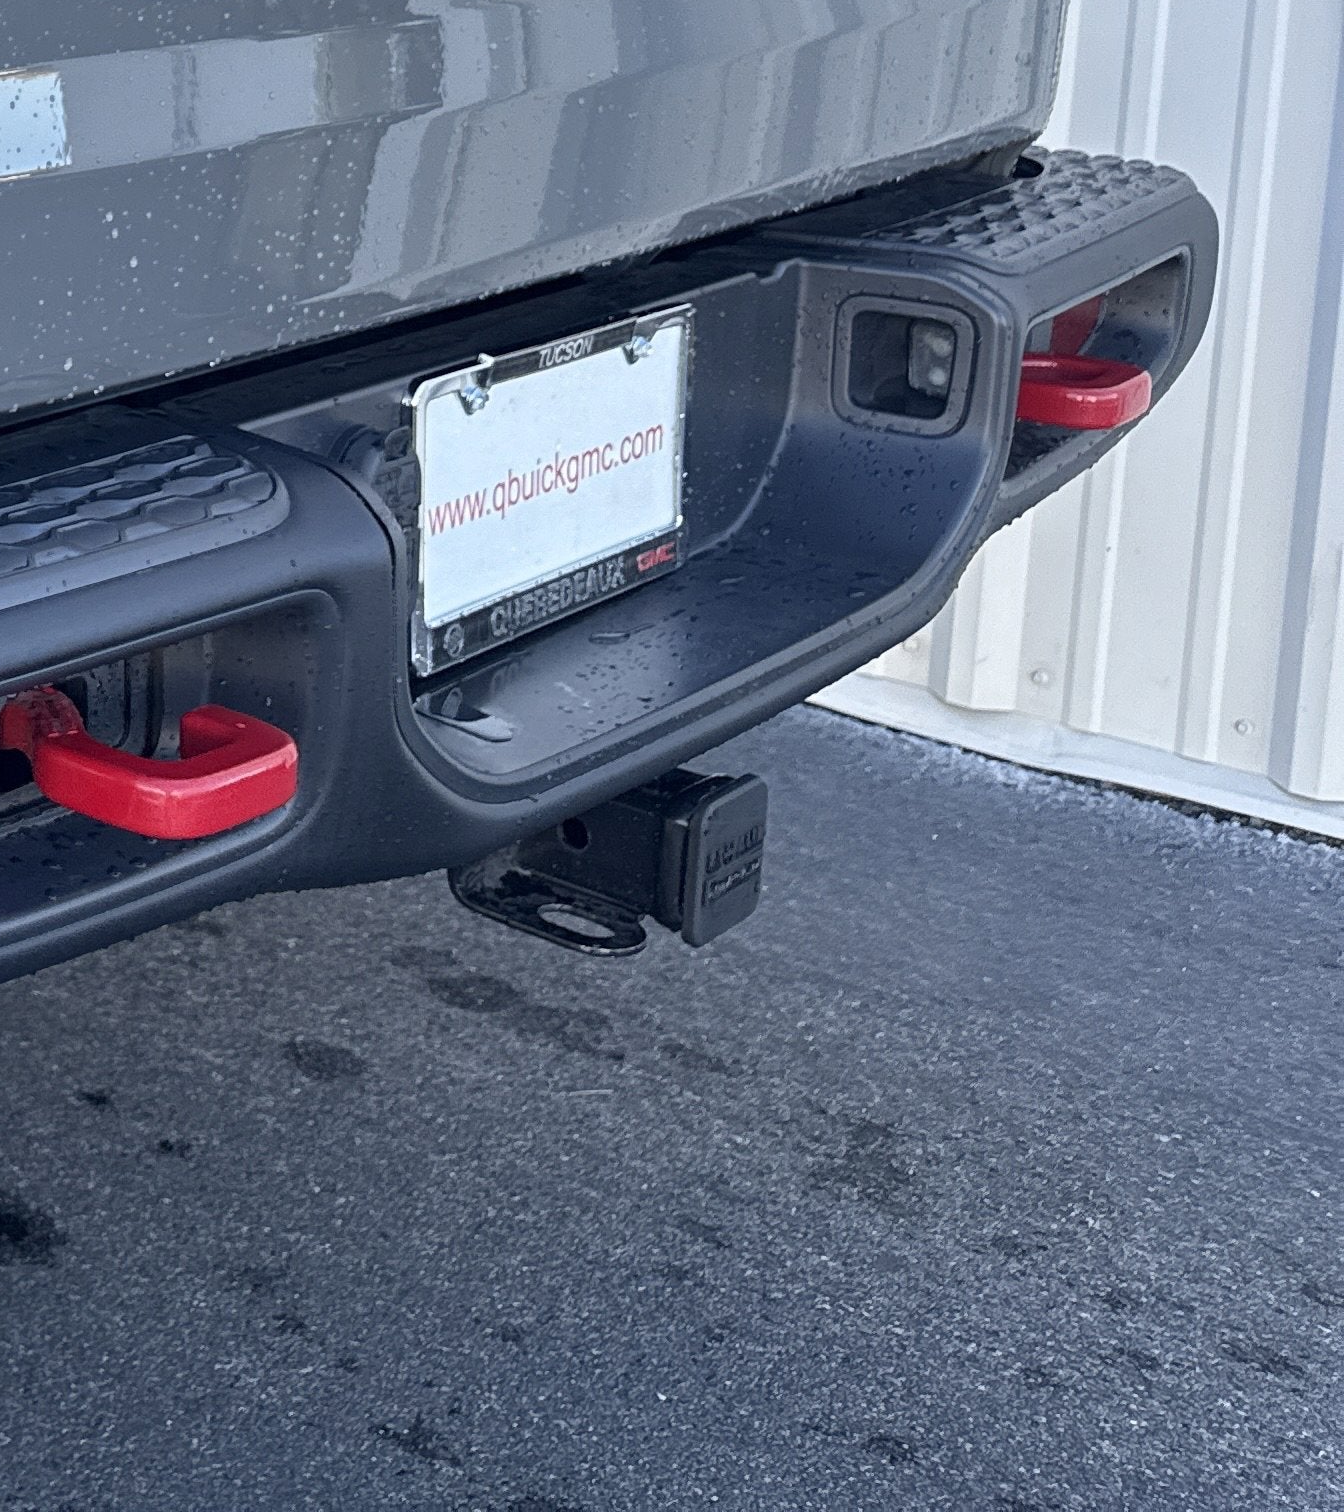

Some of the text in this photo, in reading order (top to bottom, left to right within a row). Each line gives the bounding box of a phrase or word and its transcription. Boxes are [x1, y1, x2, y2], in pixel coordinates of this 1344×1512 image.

[538, 335, 595, 369] TUCSON
[427, 423, 664, 537] www.qbuickgmc.com
[636, 541, 675, 573] GMC
